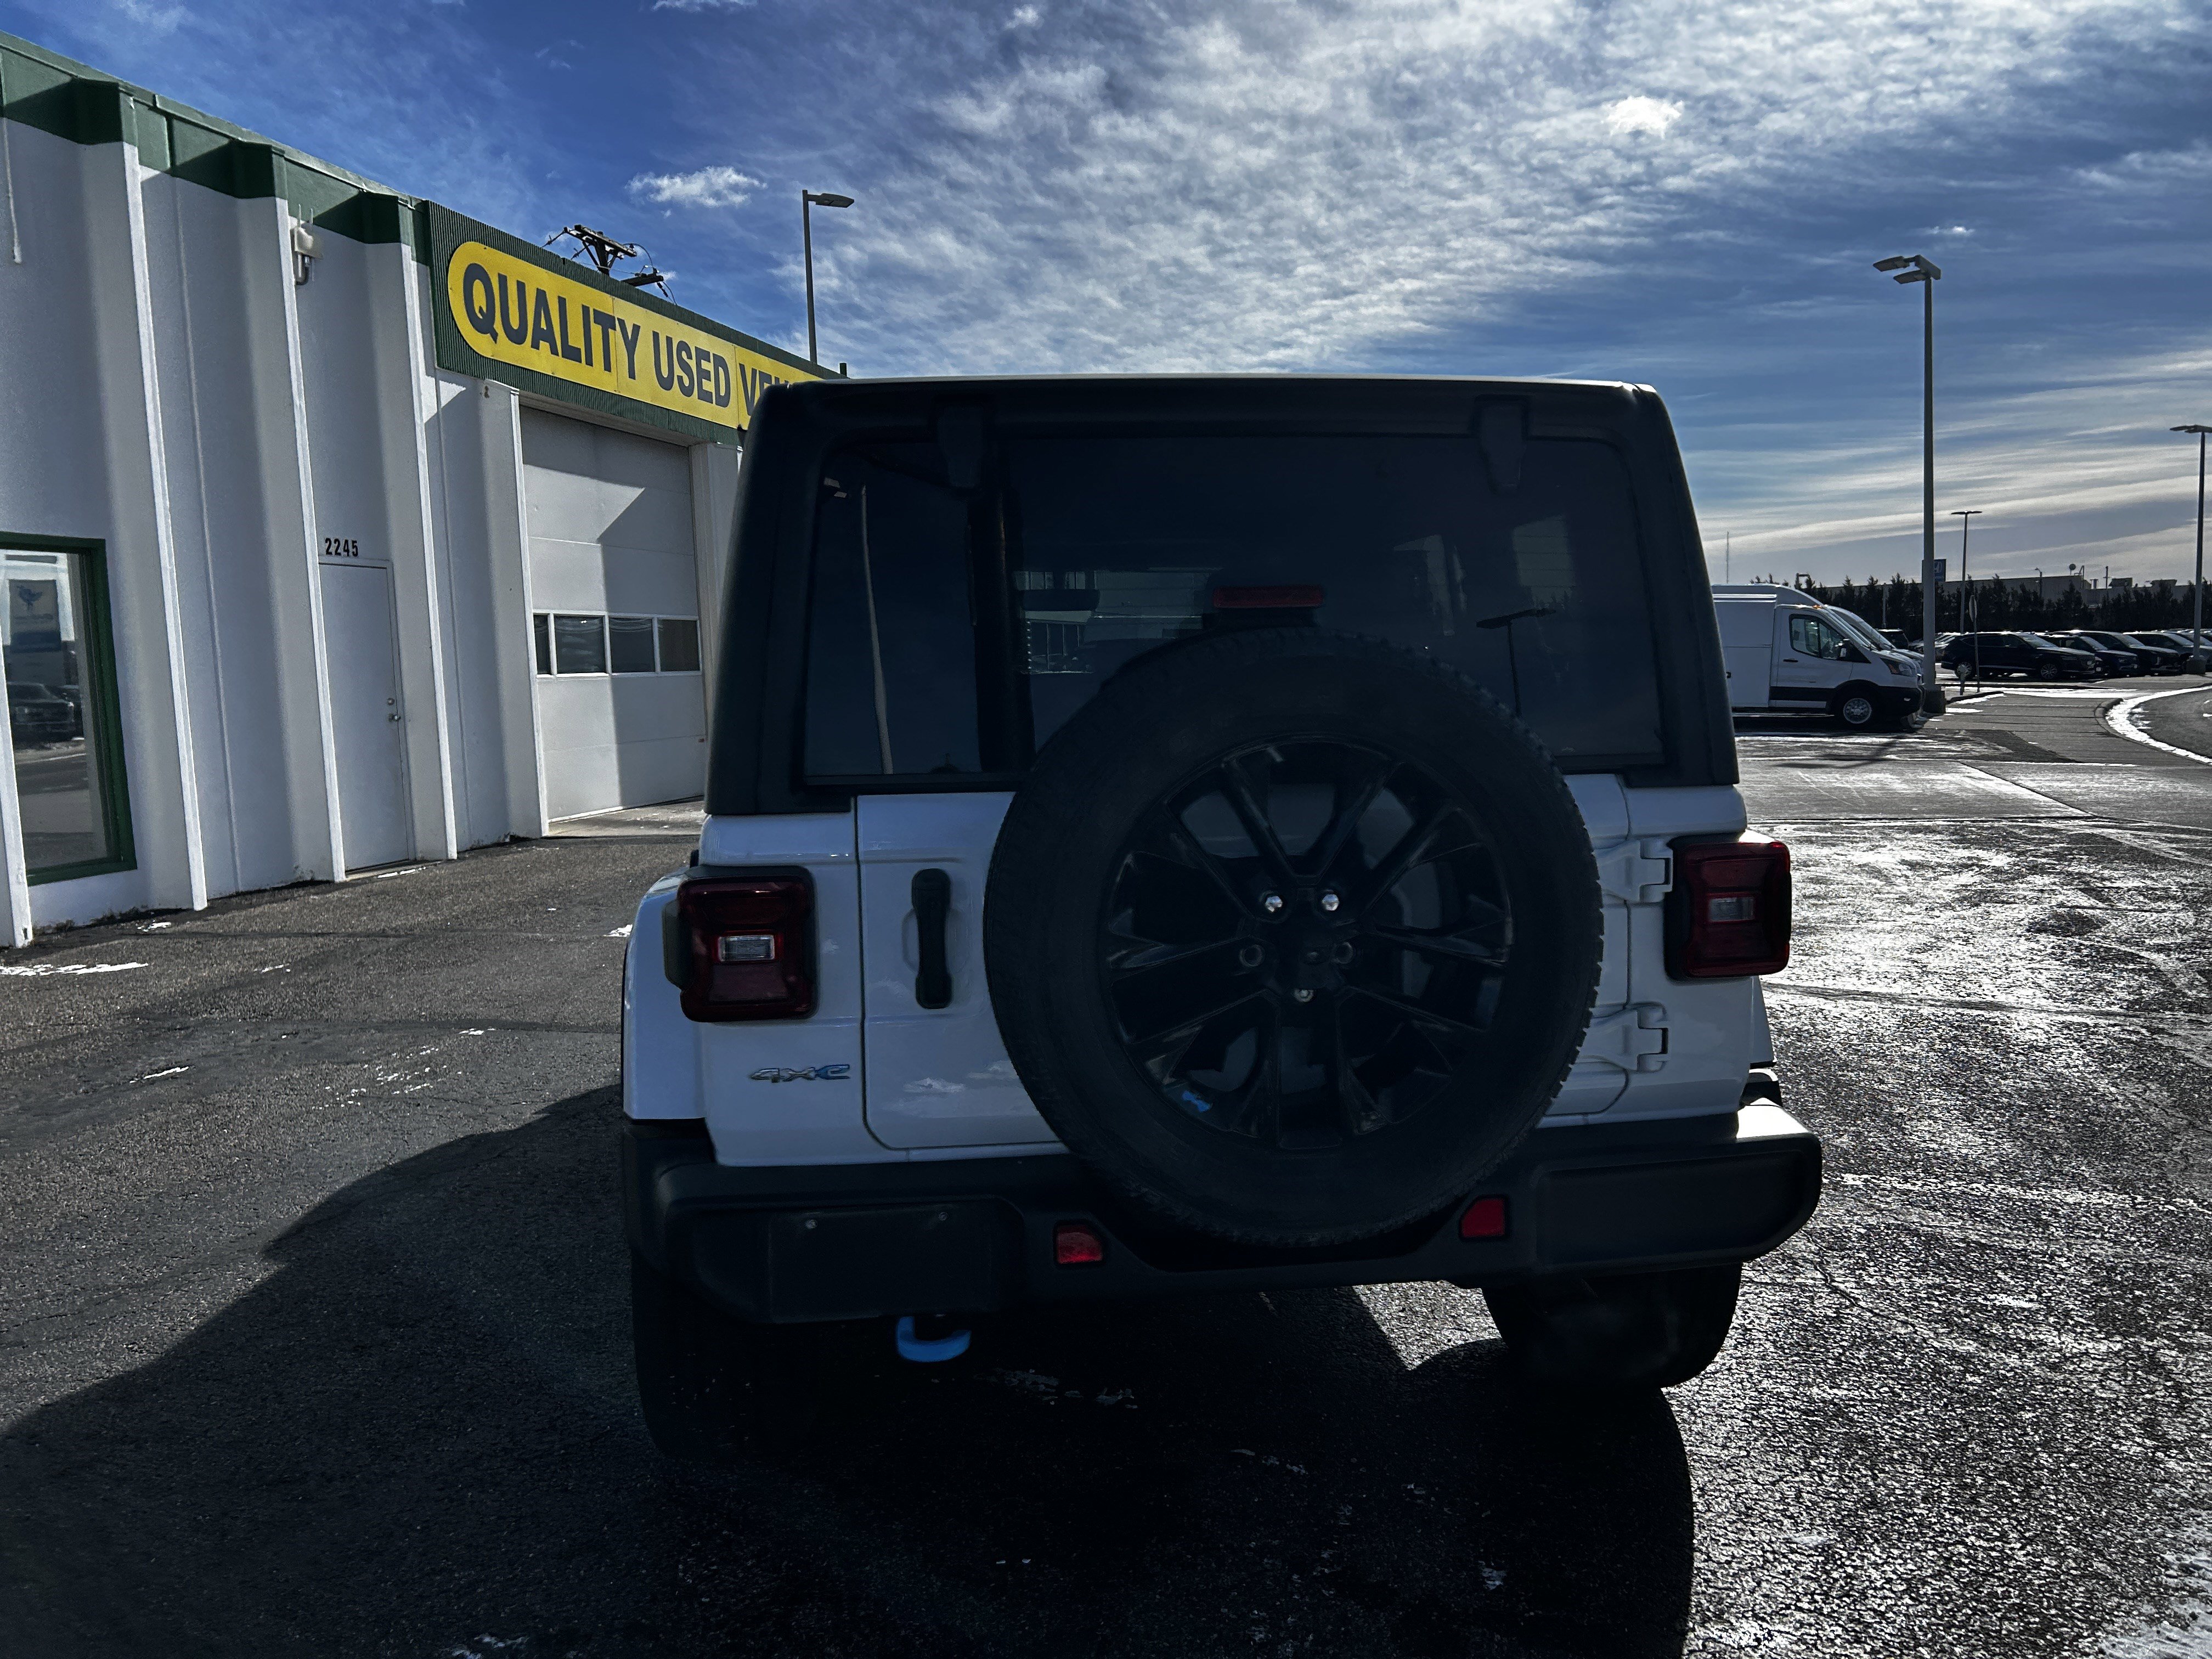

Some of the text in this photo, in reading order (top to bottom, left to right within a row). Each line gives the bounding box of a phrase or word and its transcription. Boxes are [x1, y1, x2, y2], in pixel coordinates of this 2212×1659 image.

[463, 263, 641, 381] QUALITY
[653, 330, 731, 408] USED
[325, 538, 358, 557] 2245
